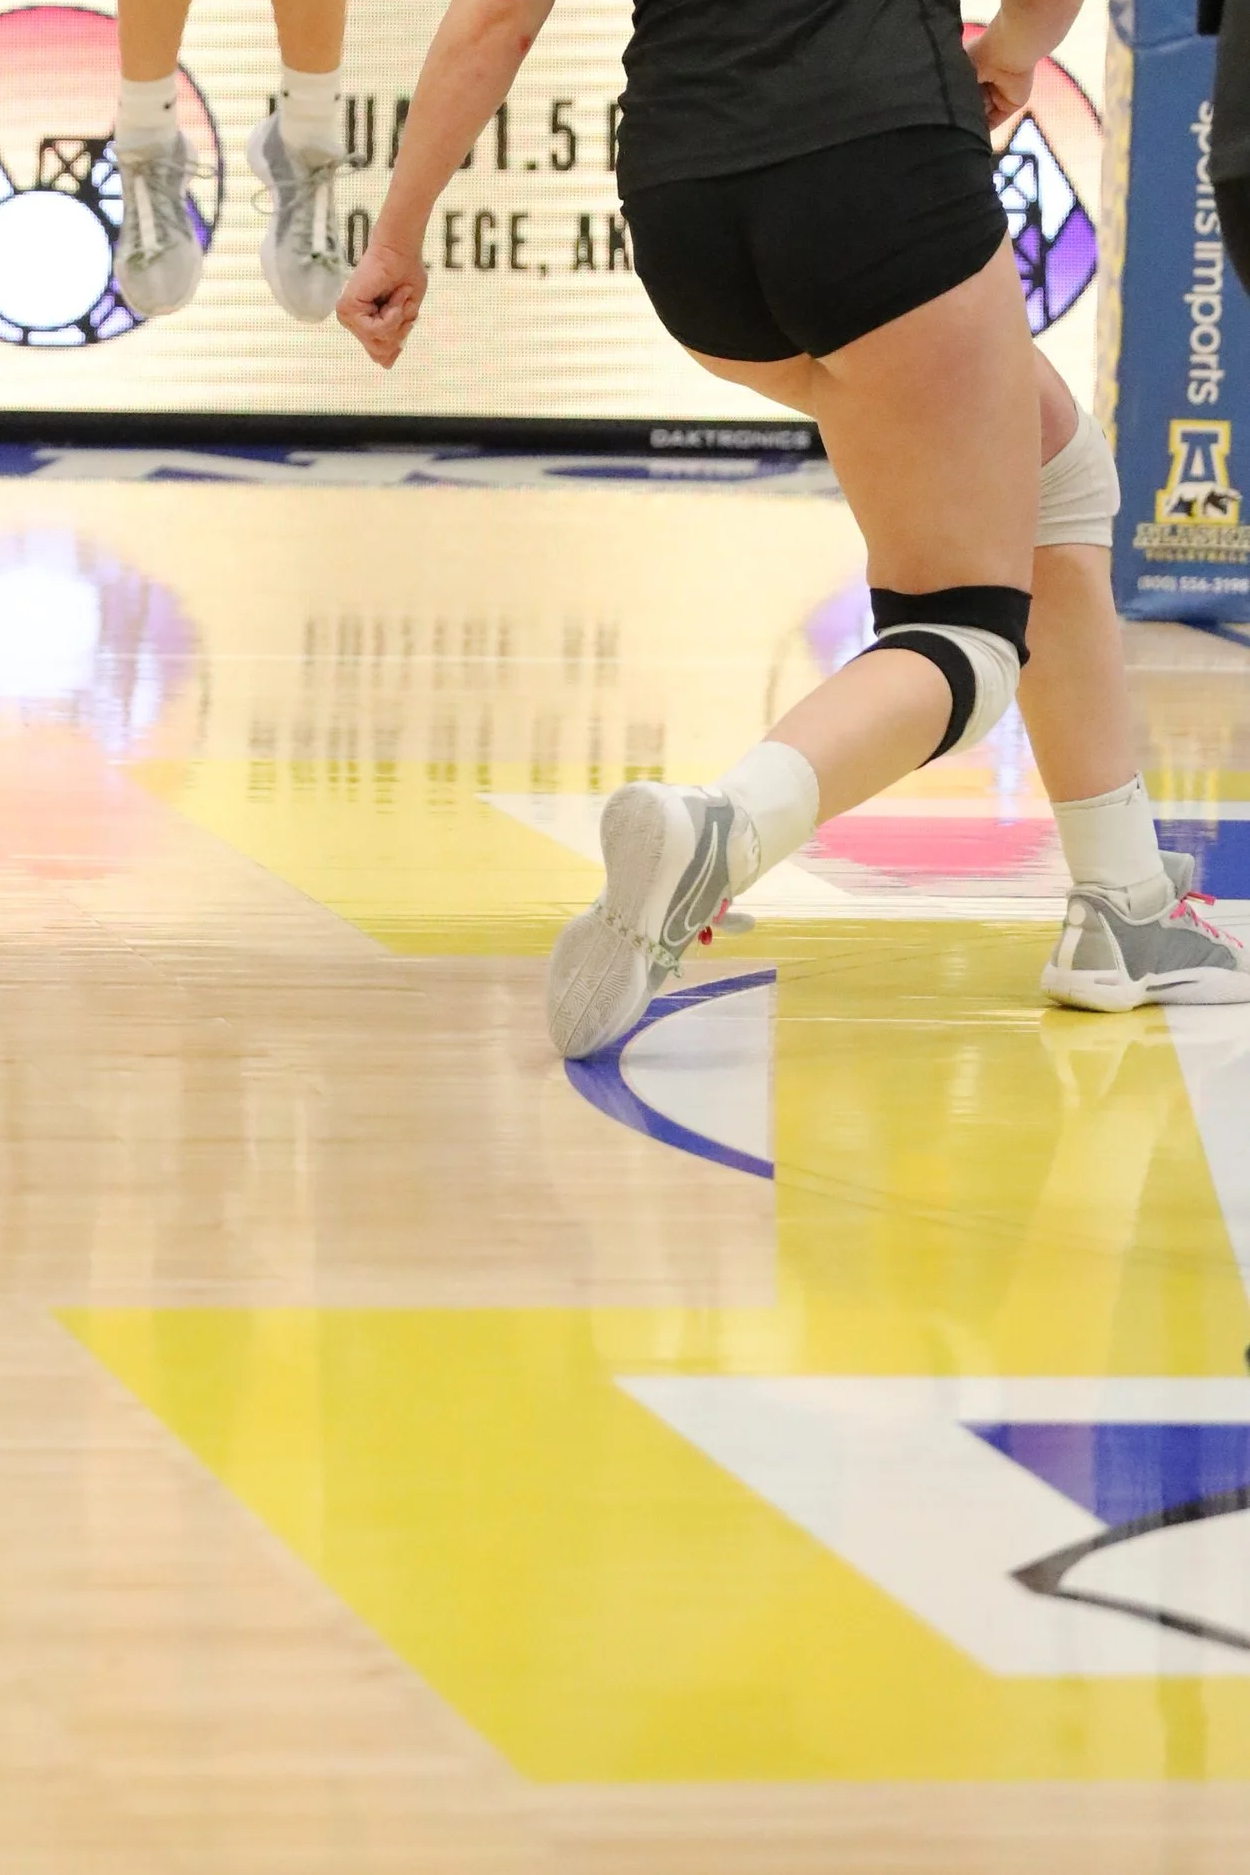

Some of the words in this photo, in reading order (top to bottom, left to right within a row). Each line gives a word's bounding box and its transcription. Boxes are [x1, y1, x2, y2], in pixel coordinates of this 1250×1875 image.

[458, 99, 577, 172] 1.5
[1183, 241, 1225, 406] imports
[650, 428, 811, 450] DAKTRONICS
